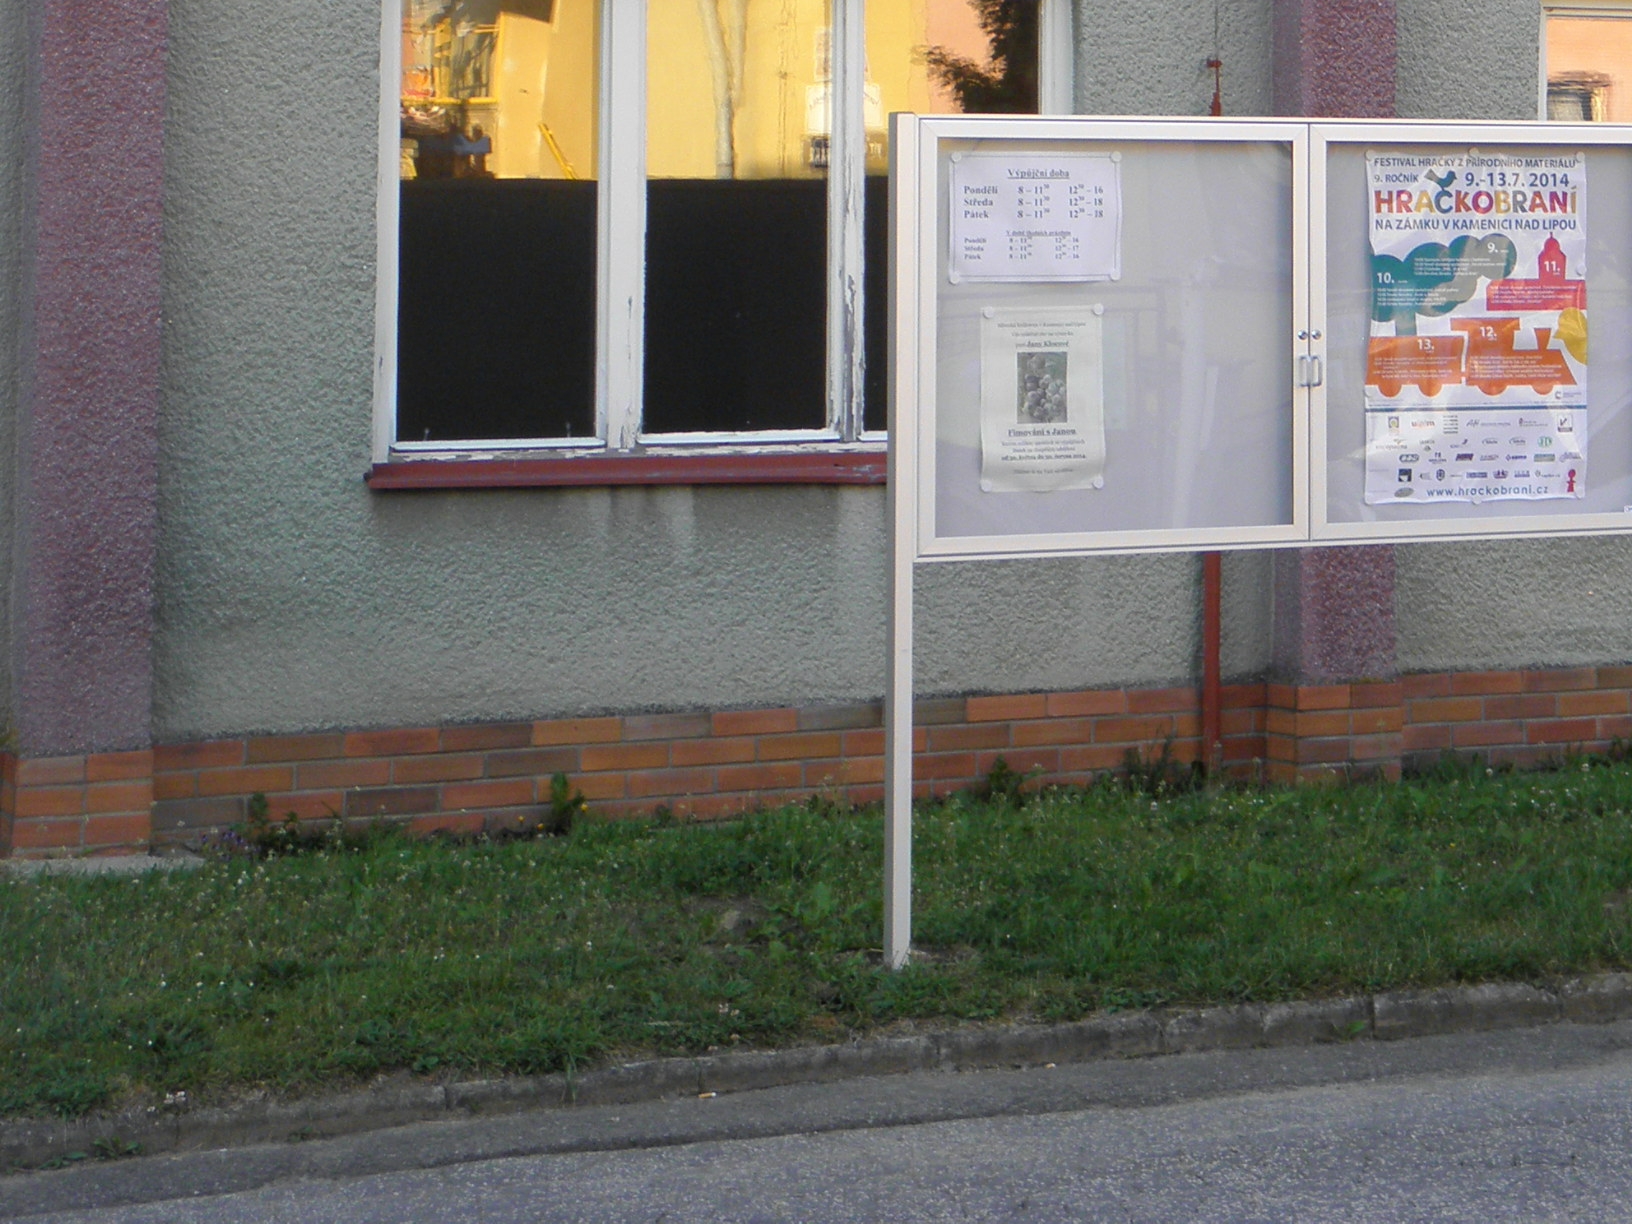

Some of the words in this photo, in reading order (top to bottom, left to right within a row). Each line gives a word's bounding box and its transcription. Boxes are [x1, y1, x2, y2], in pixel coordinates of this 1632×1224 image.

[1374, 157, 1416, 167] FESTIVAL
[1418, 156, 1455, 167] HRAČKY
[1457, 158, 1463, 167] Z
[1466, 156, 1523, 168] PŘÍRODNÍHO
[1525, 157, 1575, 168] MATERIÁLU
[1008, 168, 1048, 178] Výpůjční
[1049, 168, 1070, 177] doba
[1374, 175, 1383, 183] 9.
[1385, 172, 1419, 183] ROČNÍK
[1529, 172, 1569, 187] 2014
[964, 186, 998, 195] Pondělí
[964, 198, 993, 207] Středa
[1374, 186, 1577, 215] HRAČKOBRANÍ
[964, 210, 989, 219] Pátek
[1375, 219, 1392, 230] NA
[1395, 218, 1439, 230] ZÁMKU
[1442, 219, 1450, 230] V
[1452, 219, 1513, 230] KAMENICI
[1515, 219, 1540, 230] NAD
[1542, 219, 1577, 230] LIPOU
[1487, 242, 1498, 253] 9.
[1544, 261, 1561, 272] 11.
[1377, 272, 1394, 283] 10.
[1480, 326, 1497, 338] 12.
[1418, 340, 1434, 350] 13.
[1426, 485, 1549, 497] www.hrackobrani.cz
